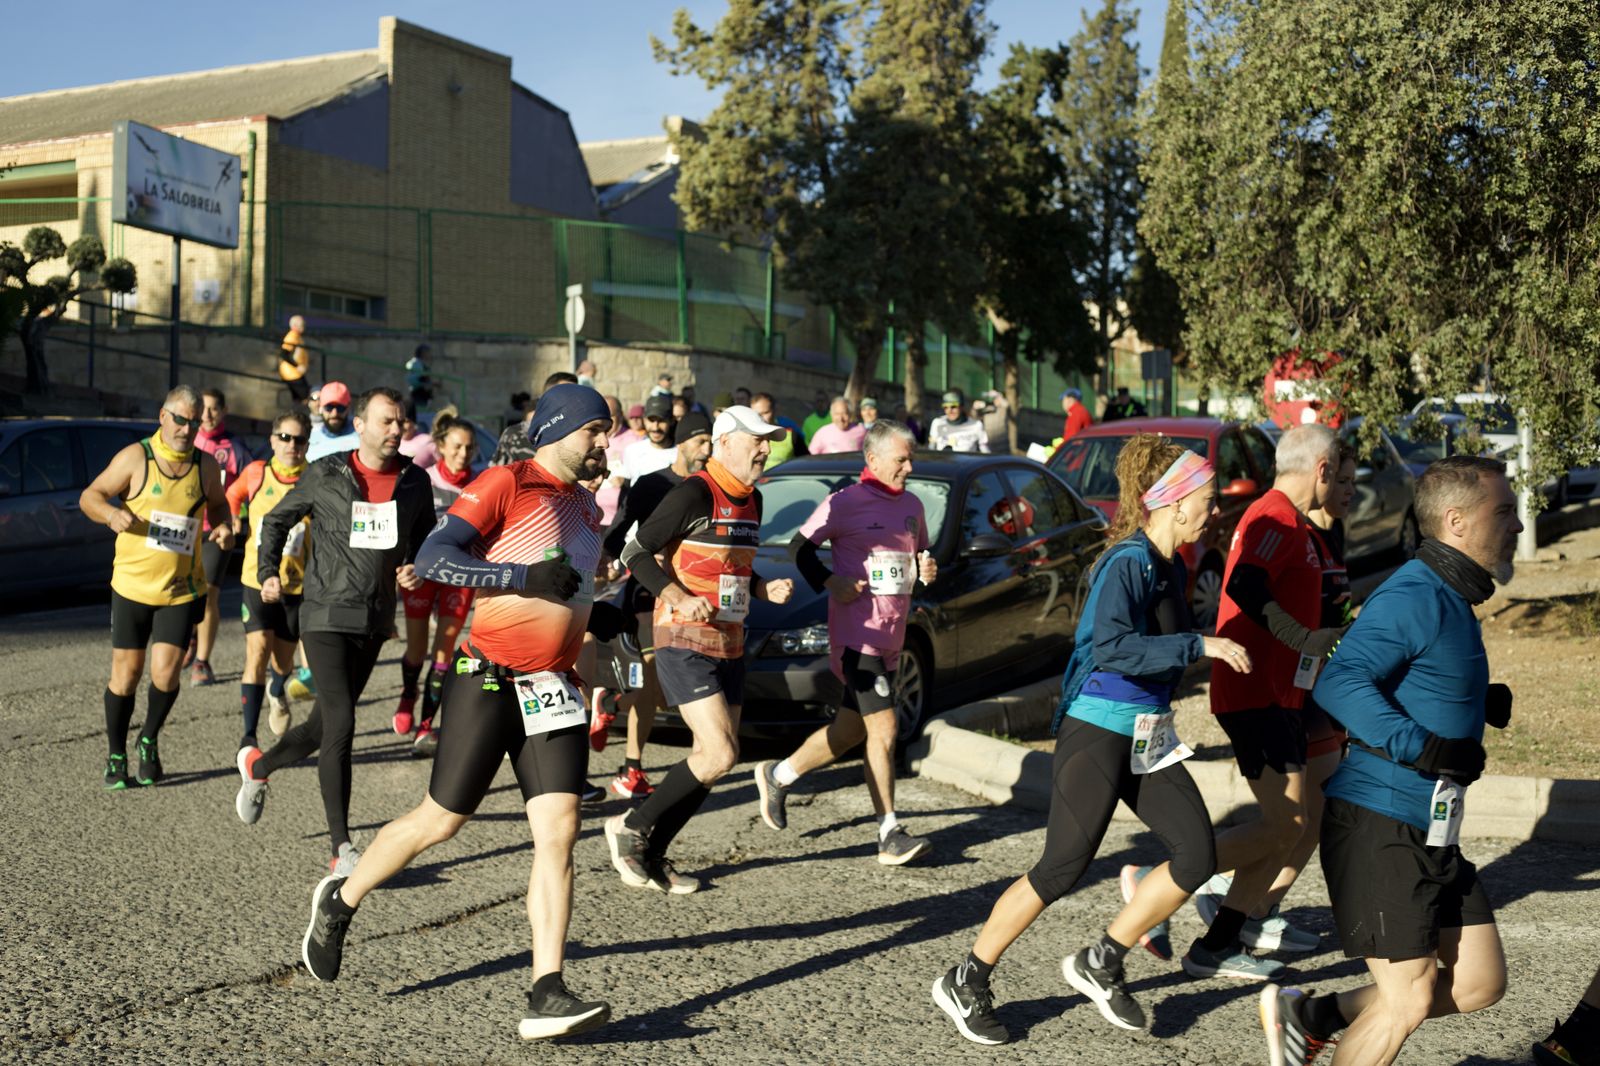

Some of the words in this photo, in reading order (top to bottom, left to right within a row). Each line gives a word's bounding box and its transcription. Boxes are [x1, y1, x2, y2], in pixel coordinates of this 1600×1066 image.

[549, 413, 565, 425] Full
[161, 527, 188, 540] 219
[889, 566, 905, 579] 91
[540, 688, 577, 709] 214
